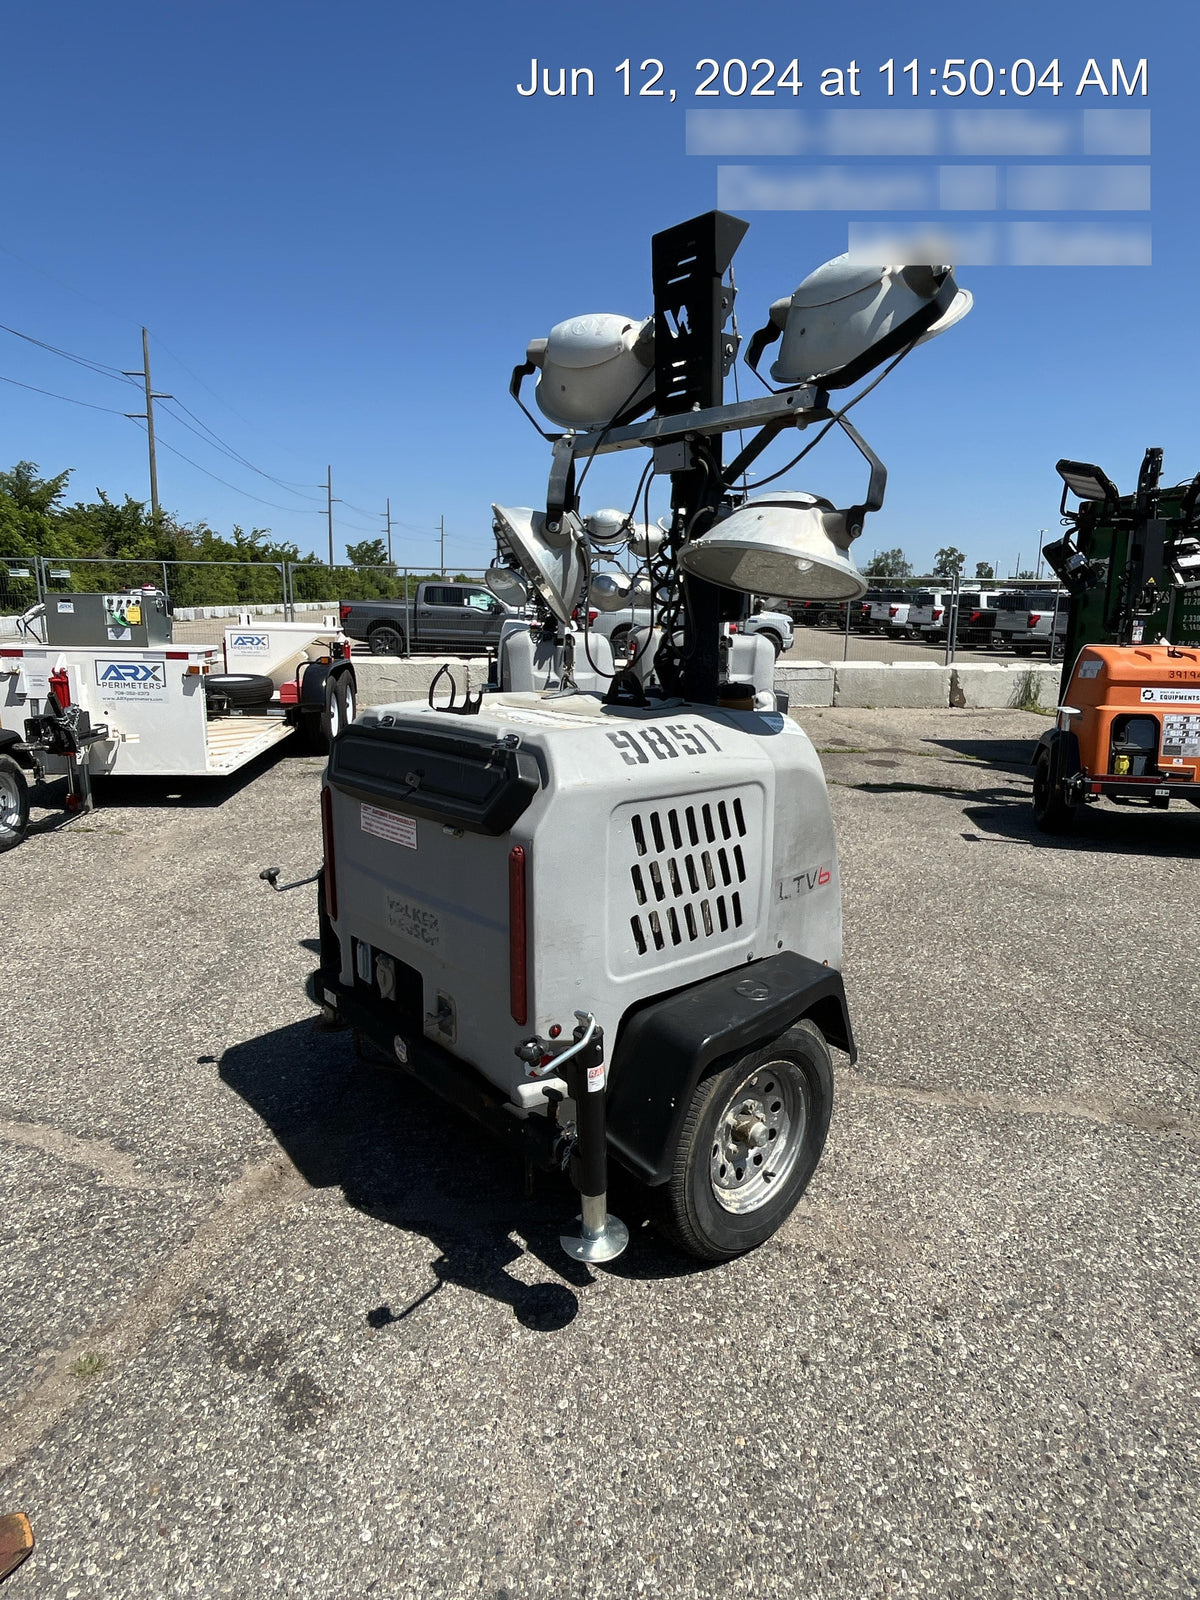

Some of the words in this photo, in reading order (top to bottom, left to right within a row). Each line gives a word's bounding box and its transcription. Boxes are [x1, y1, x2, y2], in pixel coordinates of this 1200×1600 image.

[233, 636, 266, 646] ARX
[100, 664, 162, 682] ARX
[101, 681, 162, 690] PERIMETERS
[605, 723, 722, 765] 9851
